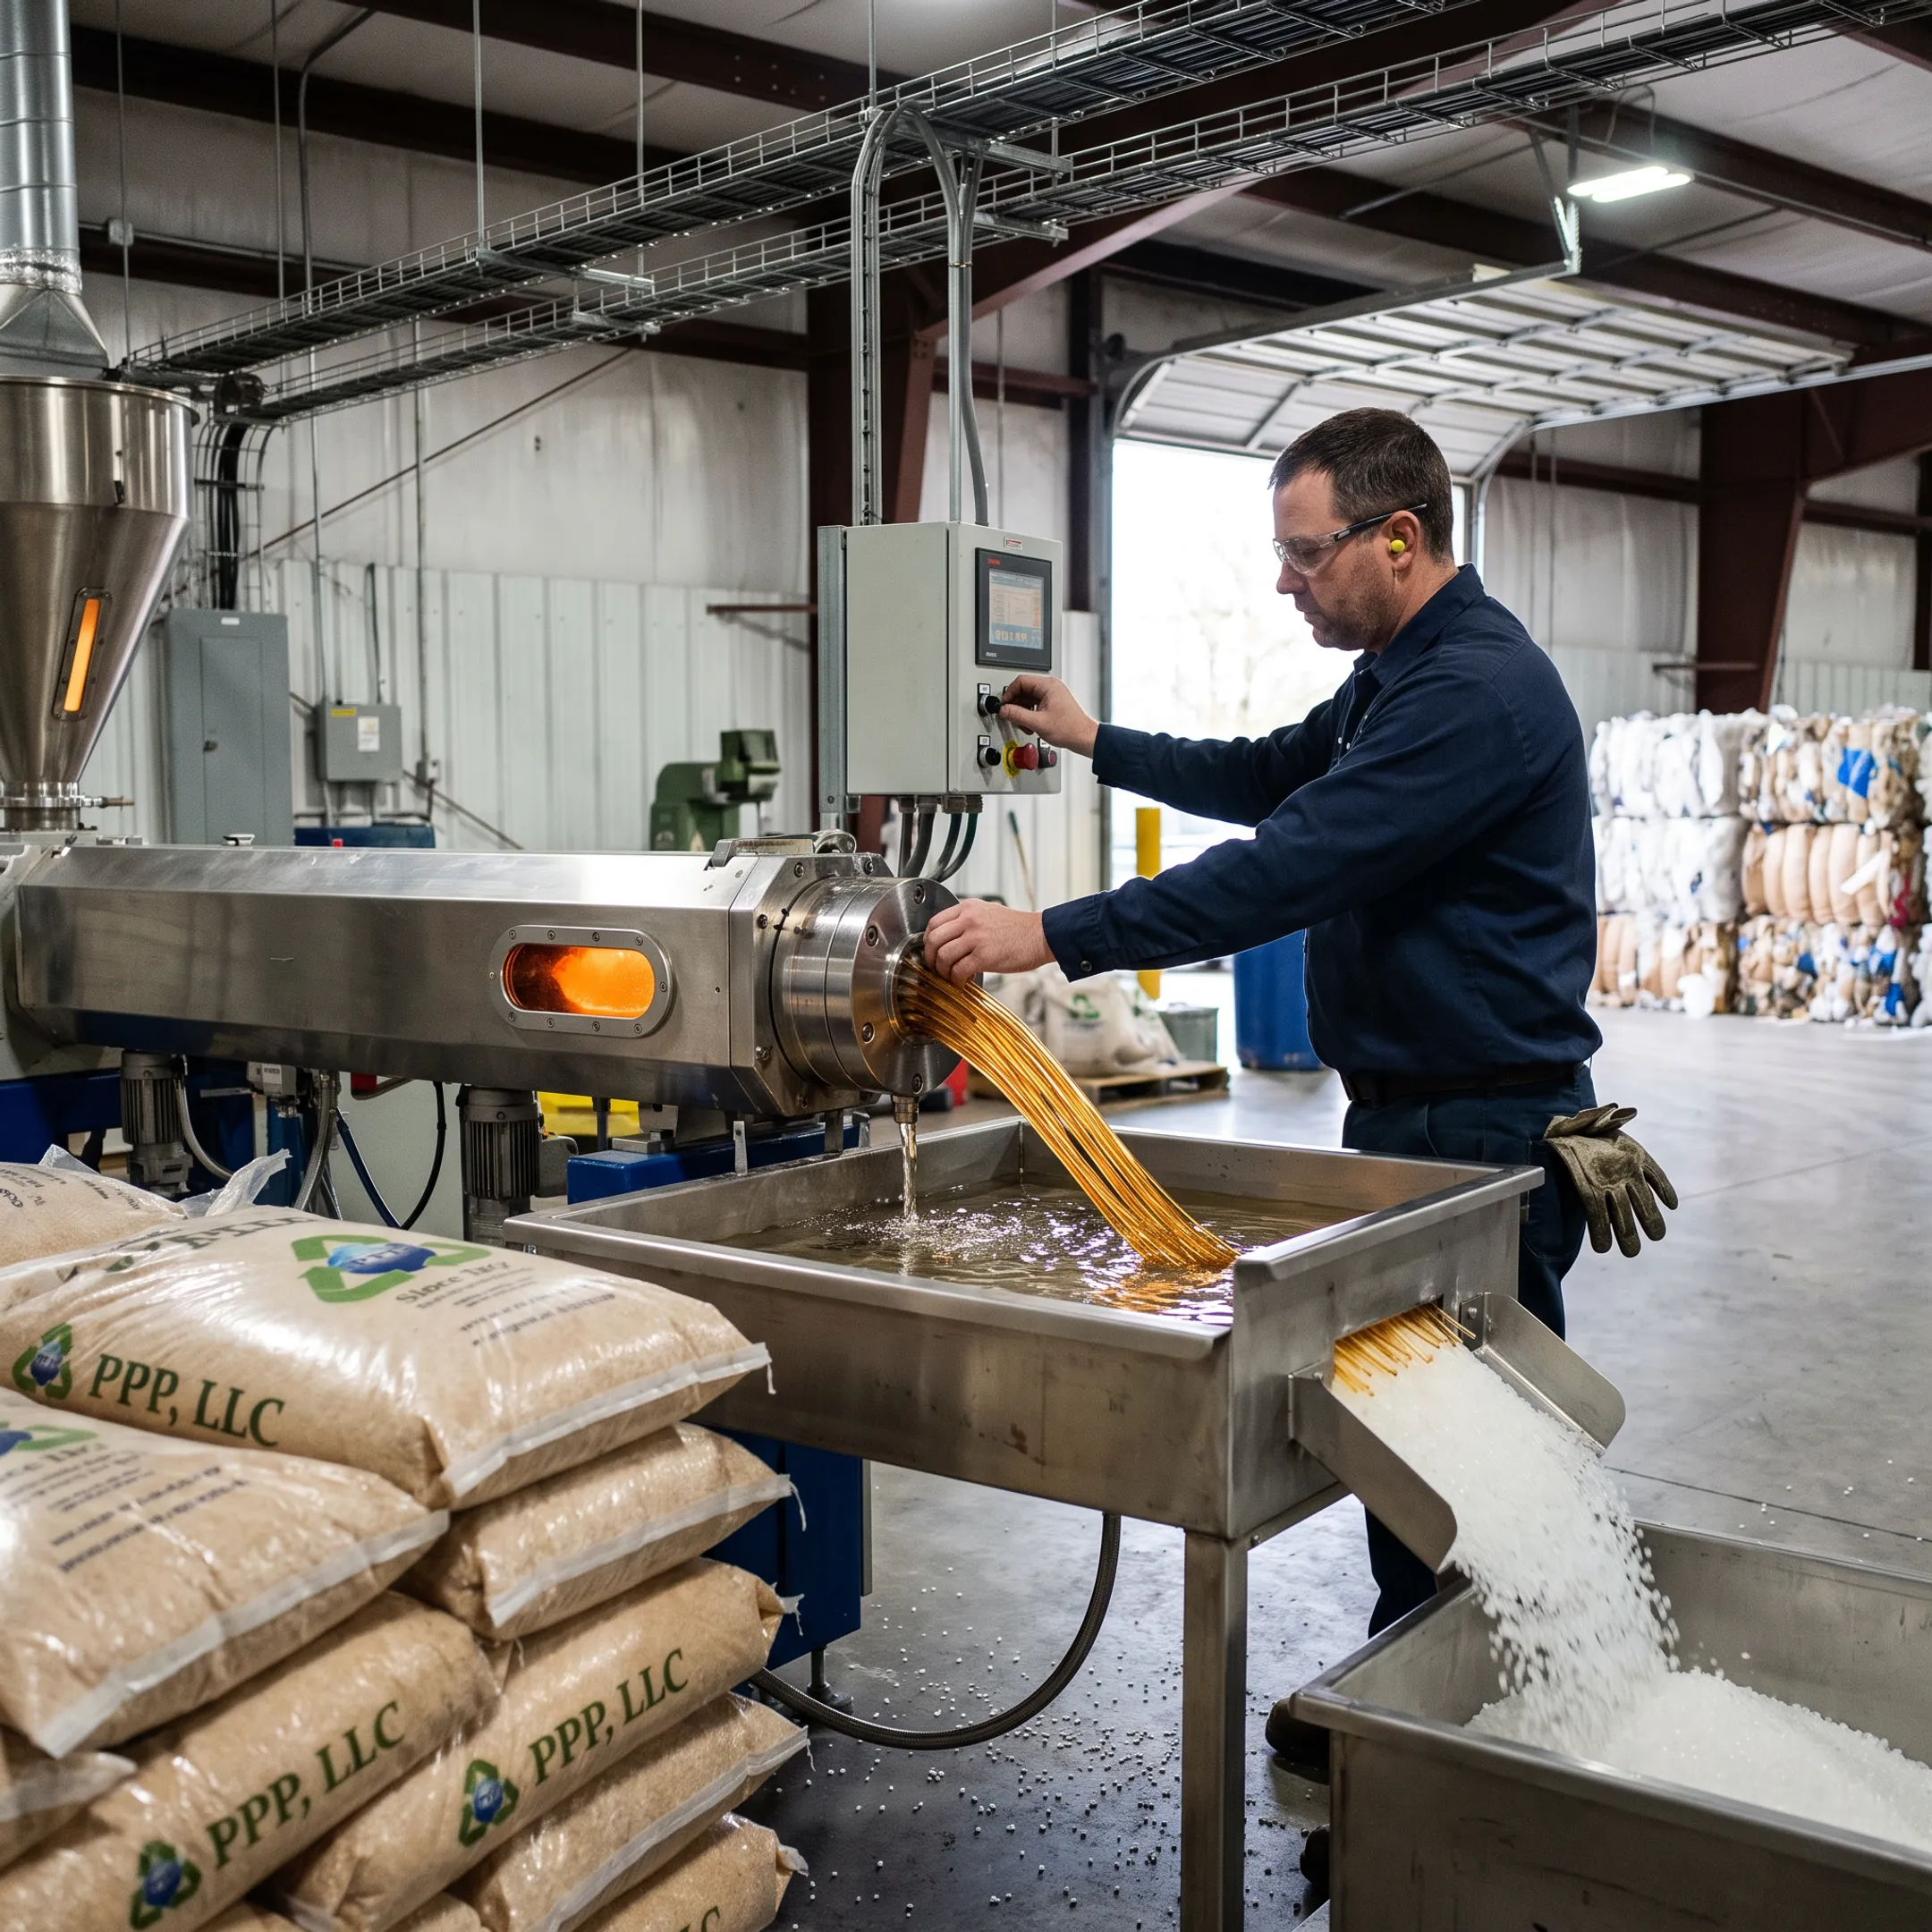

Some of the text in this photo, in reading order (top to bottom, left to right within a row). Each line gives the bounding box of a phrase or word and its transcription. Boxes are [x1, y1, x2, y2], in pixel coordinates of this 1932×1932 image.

[88, 1353, 285, 1448] PPP, LLC
[206, 1700, 405, 1869] PPP, LLC
[529, 1648, 689, 1787] PPP, LLC
